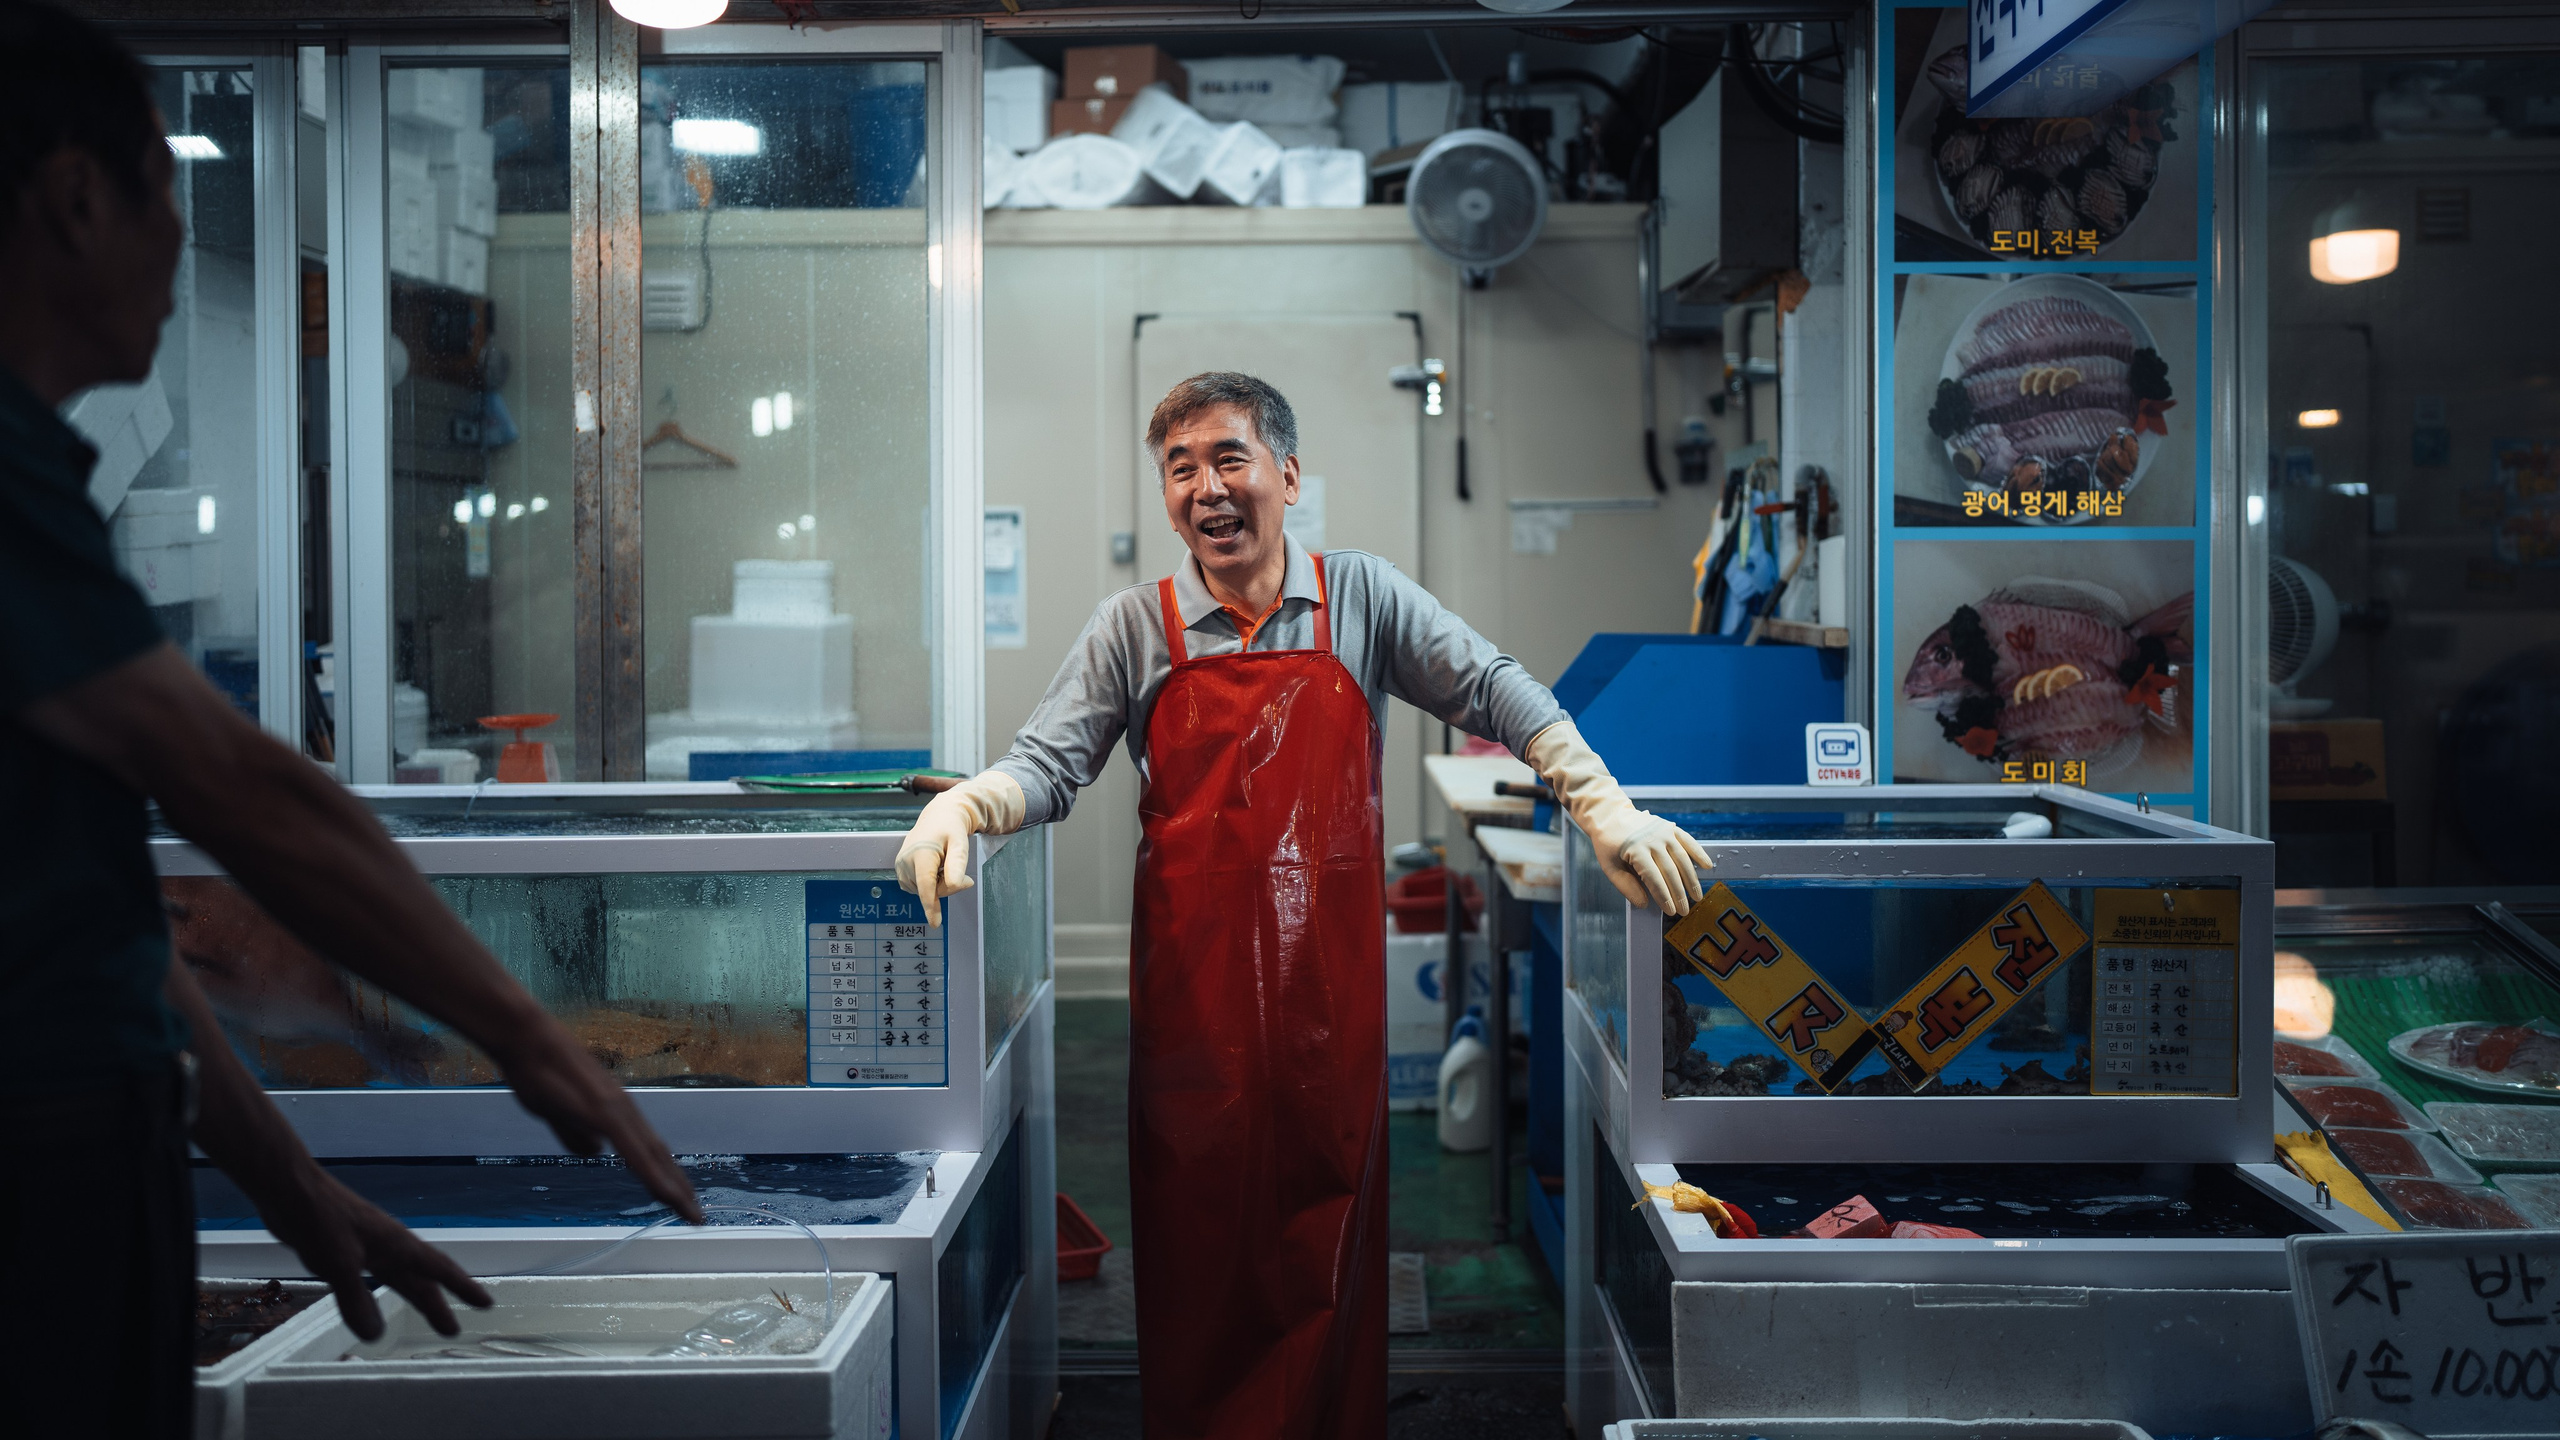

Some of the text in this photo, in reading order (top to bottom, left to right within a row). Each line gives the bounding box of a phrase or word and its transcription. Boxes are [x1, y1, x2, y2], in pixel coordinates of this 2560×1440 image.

[1989, 228, 2101, 256] 도미.전복
[1961, 489, 2127, 518] 광어.멍게.해삼
[839, 903, 912, 919] 원산지 표시
[2117, 915, 2216, 928] 원산지 표시는 고객과의
[894, 926, 925, 938] 원산지
[2112, 929, 2221, 940] 소중한 신뢰의 시작입니다
[2150, 959, 2187, 972] 원산지
[2103, 1023, 2136, 1033] 고등어
